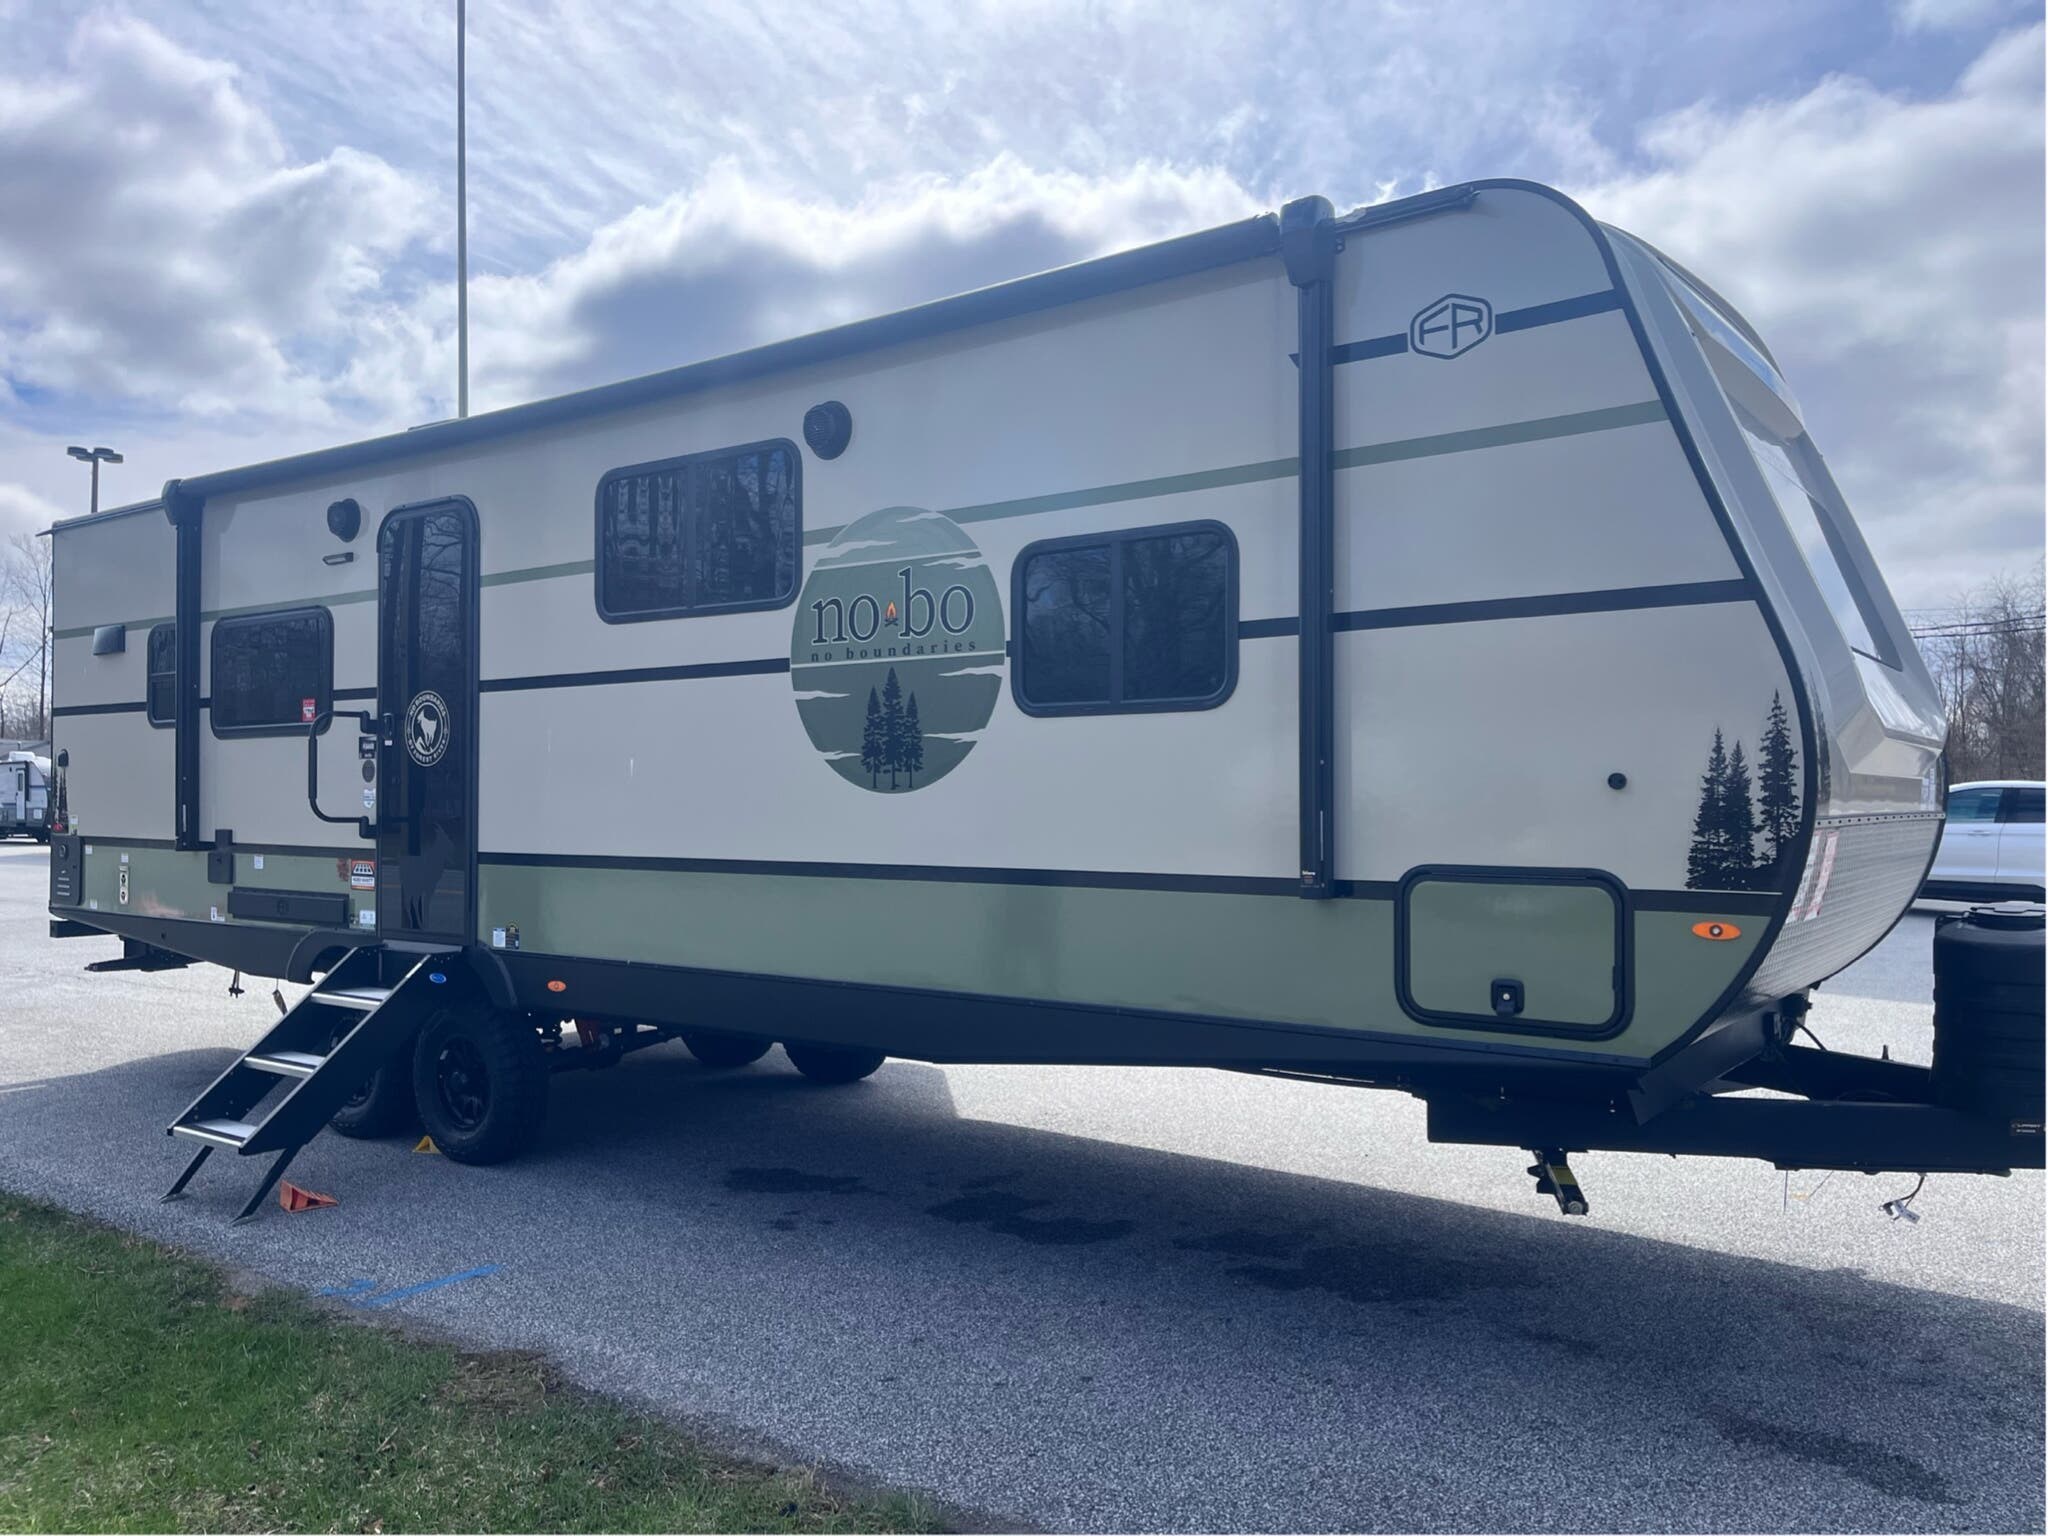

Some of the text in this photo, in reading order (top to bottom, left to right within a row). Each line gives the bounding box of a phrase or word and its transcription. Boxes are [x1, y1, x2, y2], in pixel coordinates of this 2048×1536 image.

[811, 566, 975, 645] no bo
[811, 640, 977, 661] no boundaries
